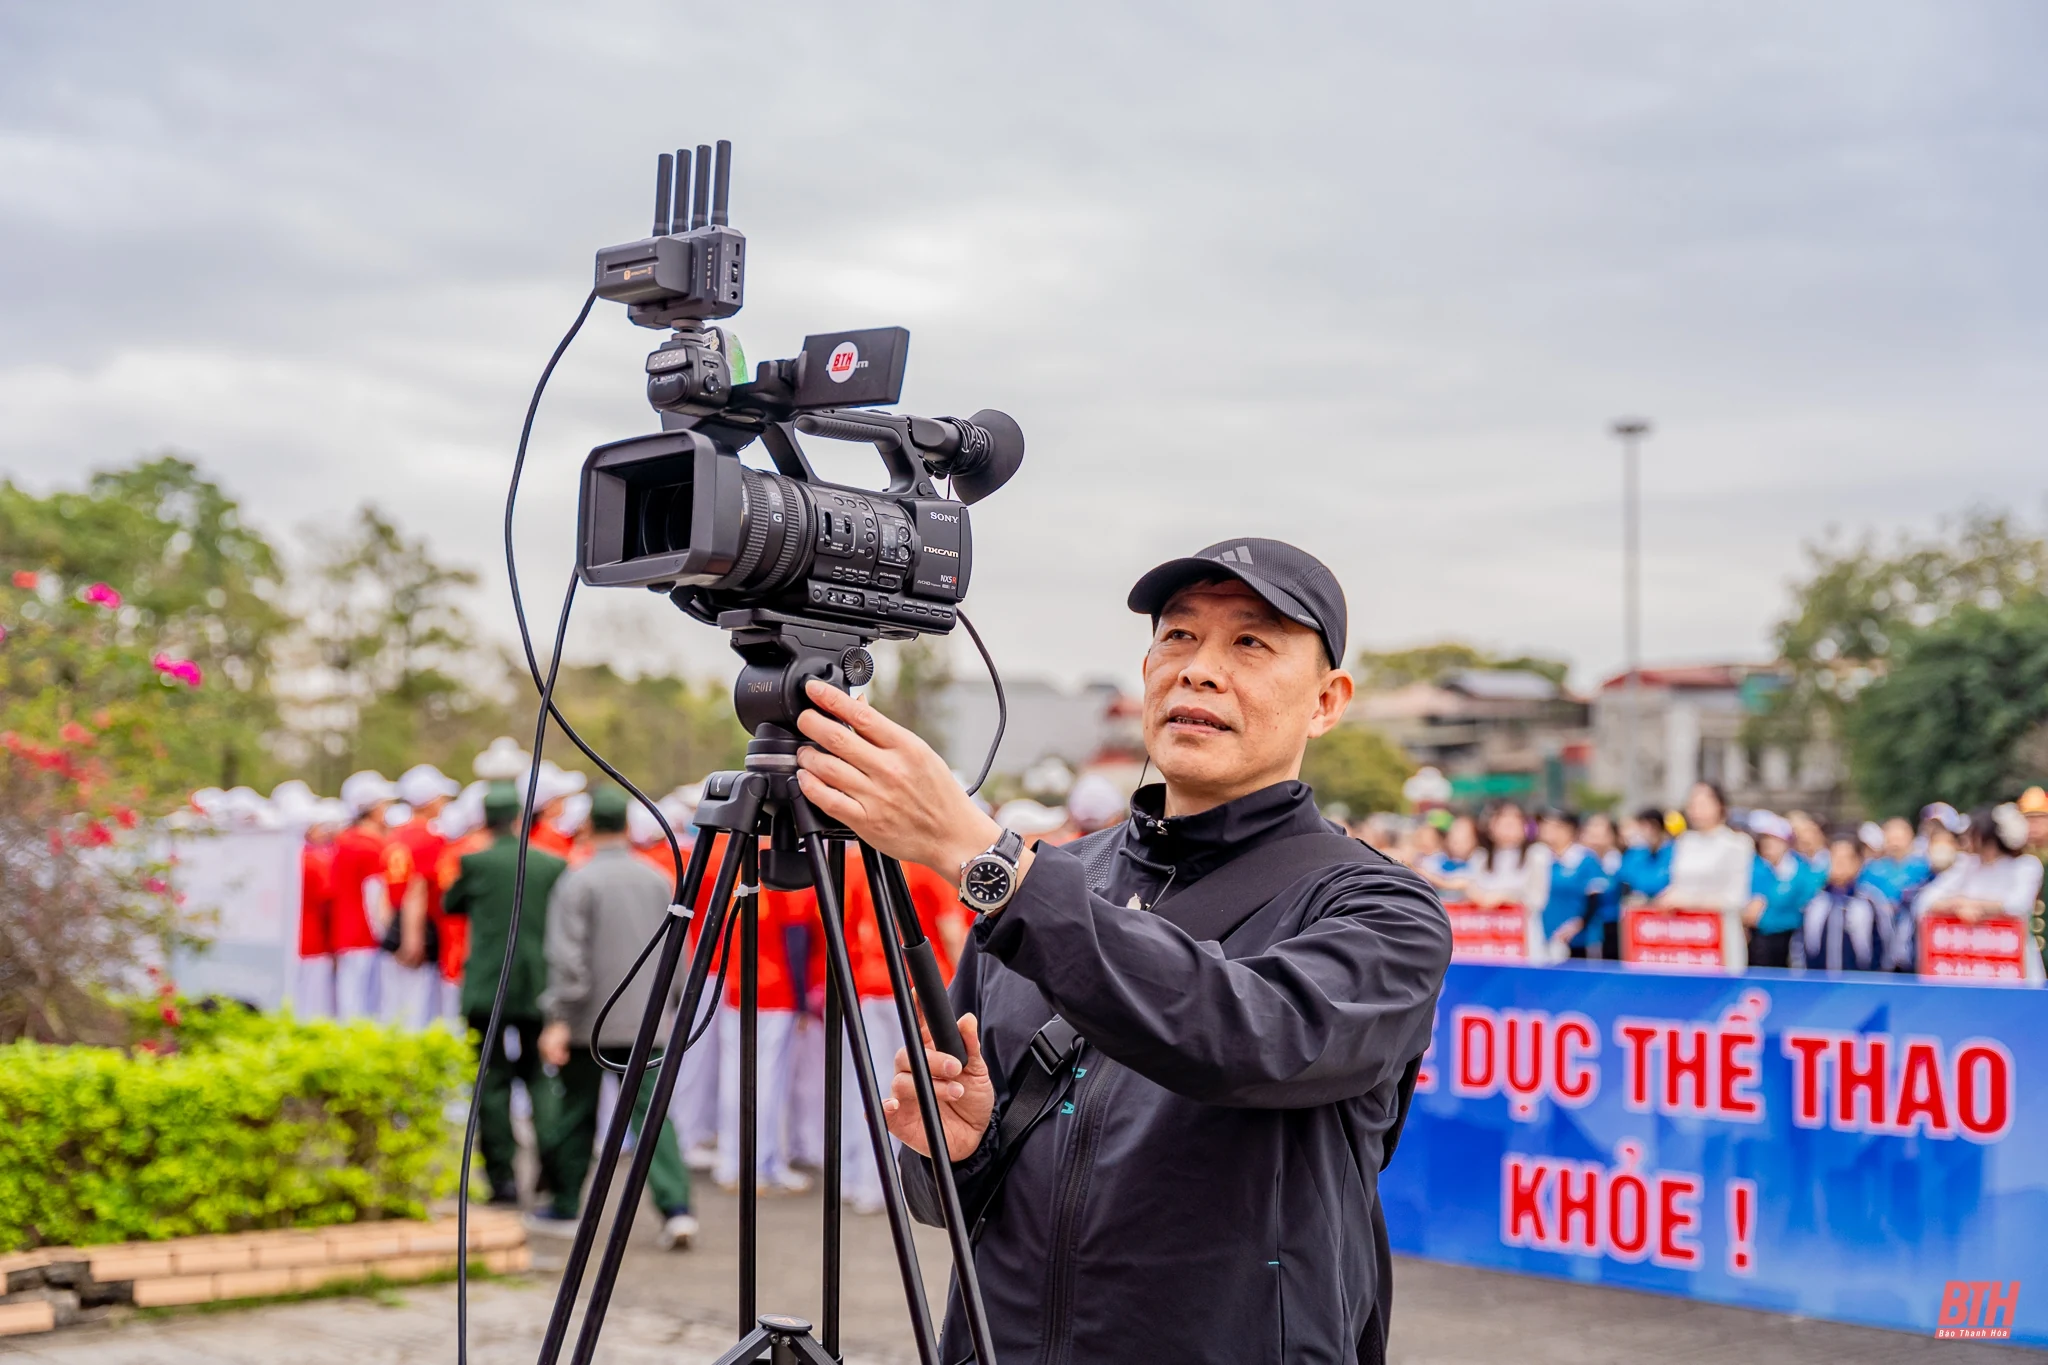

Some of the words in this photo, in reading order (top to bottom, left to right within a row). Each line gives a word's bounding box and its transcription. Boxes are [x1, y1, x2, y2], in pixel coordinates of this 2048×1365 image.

[833, 352, 854, 367] BTH
[772, 513, 783, 523] G
[930, 511, 959, 524] SONY
[1457, 1011, 1595, 1116] DỤC
[1619, 995, 1766, 1116] THỂ
[1785, 1031, 2010, 1138] THAO
[1505, 1144, 1698, 1265] KHỎE
[1732, 1182, 1754, 1270] !
